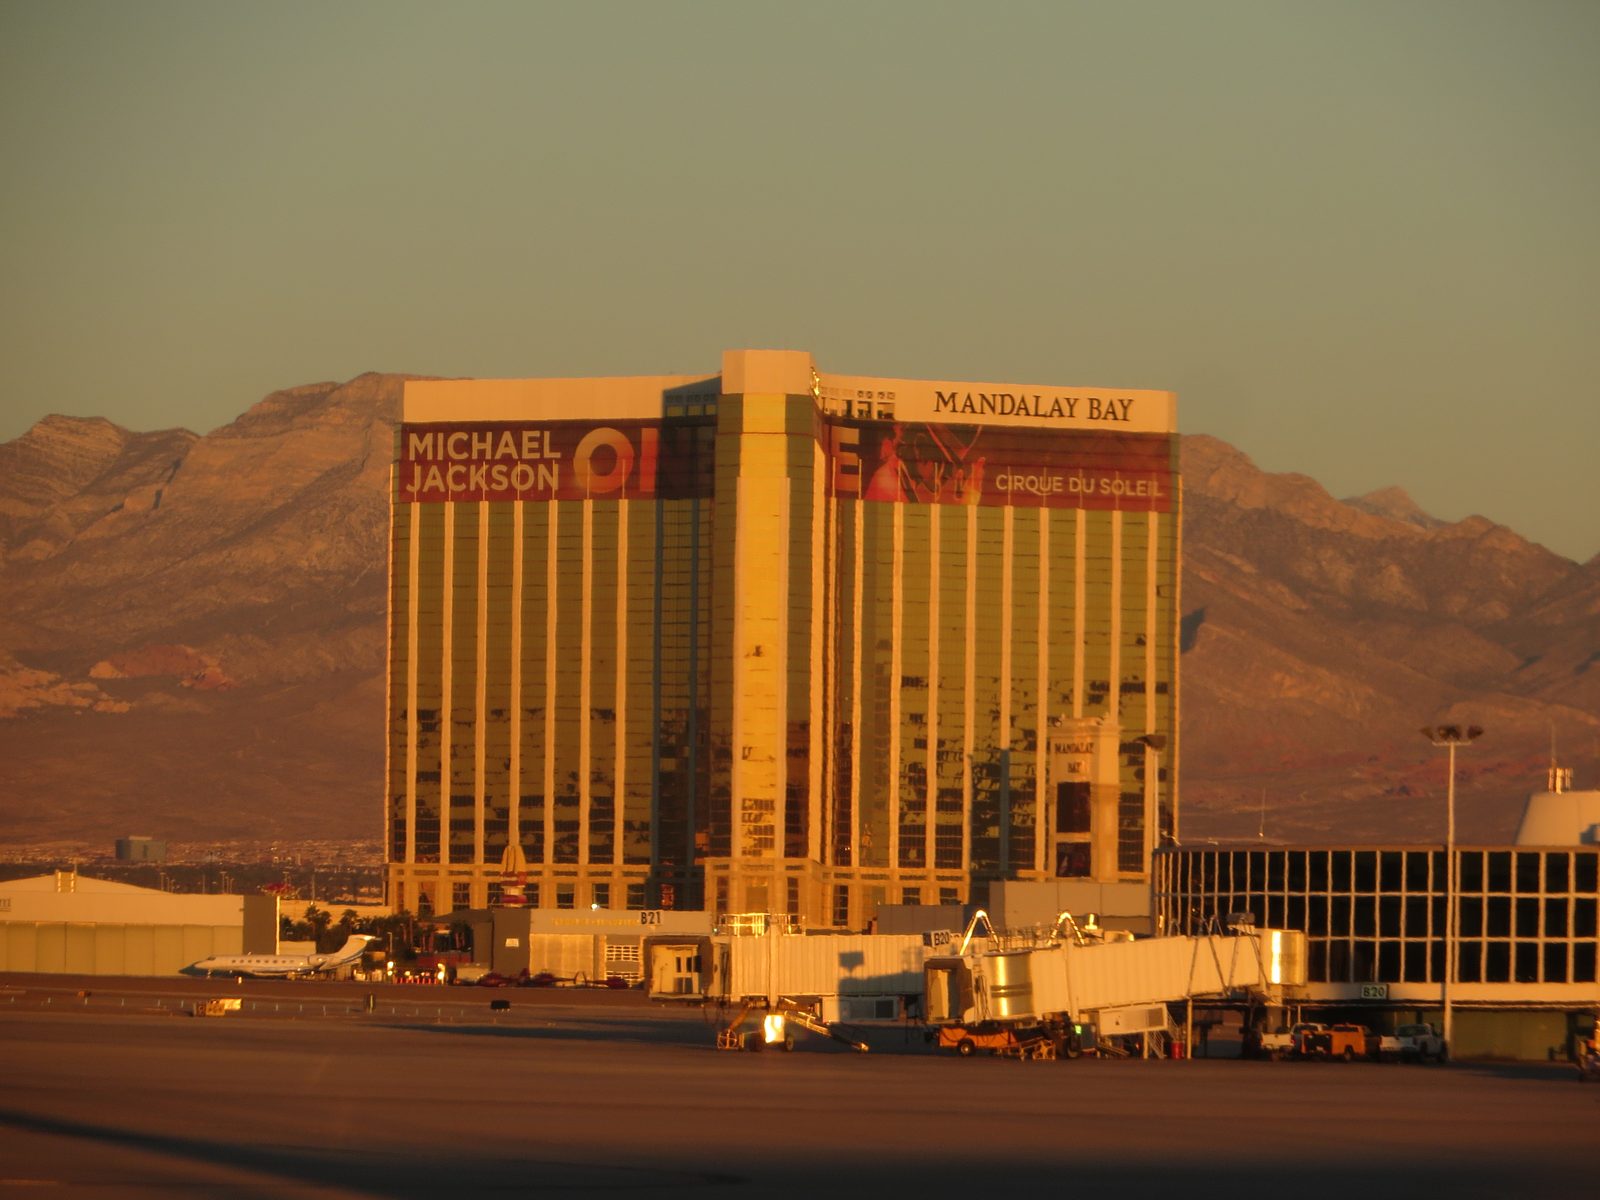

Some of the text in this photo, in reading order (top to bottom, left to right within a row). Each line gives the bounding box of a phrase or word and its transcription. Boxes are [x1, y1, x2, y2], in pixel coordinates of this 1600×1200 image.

[934, 391, 1134, 422] MANDALAY BAY
[408, 430, 561, 461] MICHAEL
[406, 463, 560, 493] JACKSON
[995, 474, 1164, 497] CIRQUE DU SOLEIL
[640, 911, 661, 925] B21
[934, 931, 950, 946] B20
[1363, 986, 1385, 998] B20
